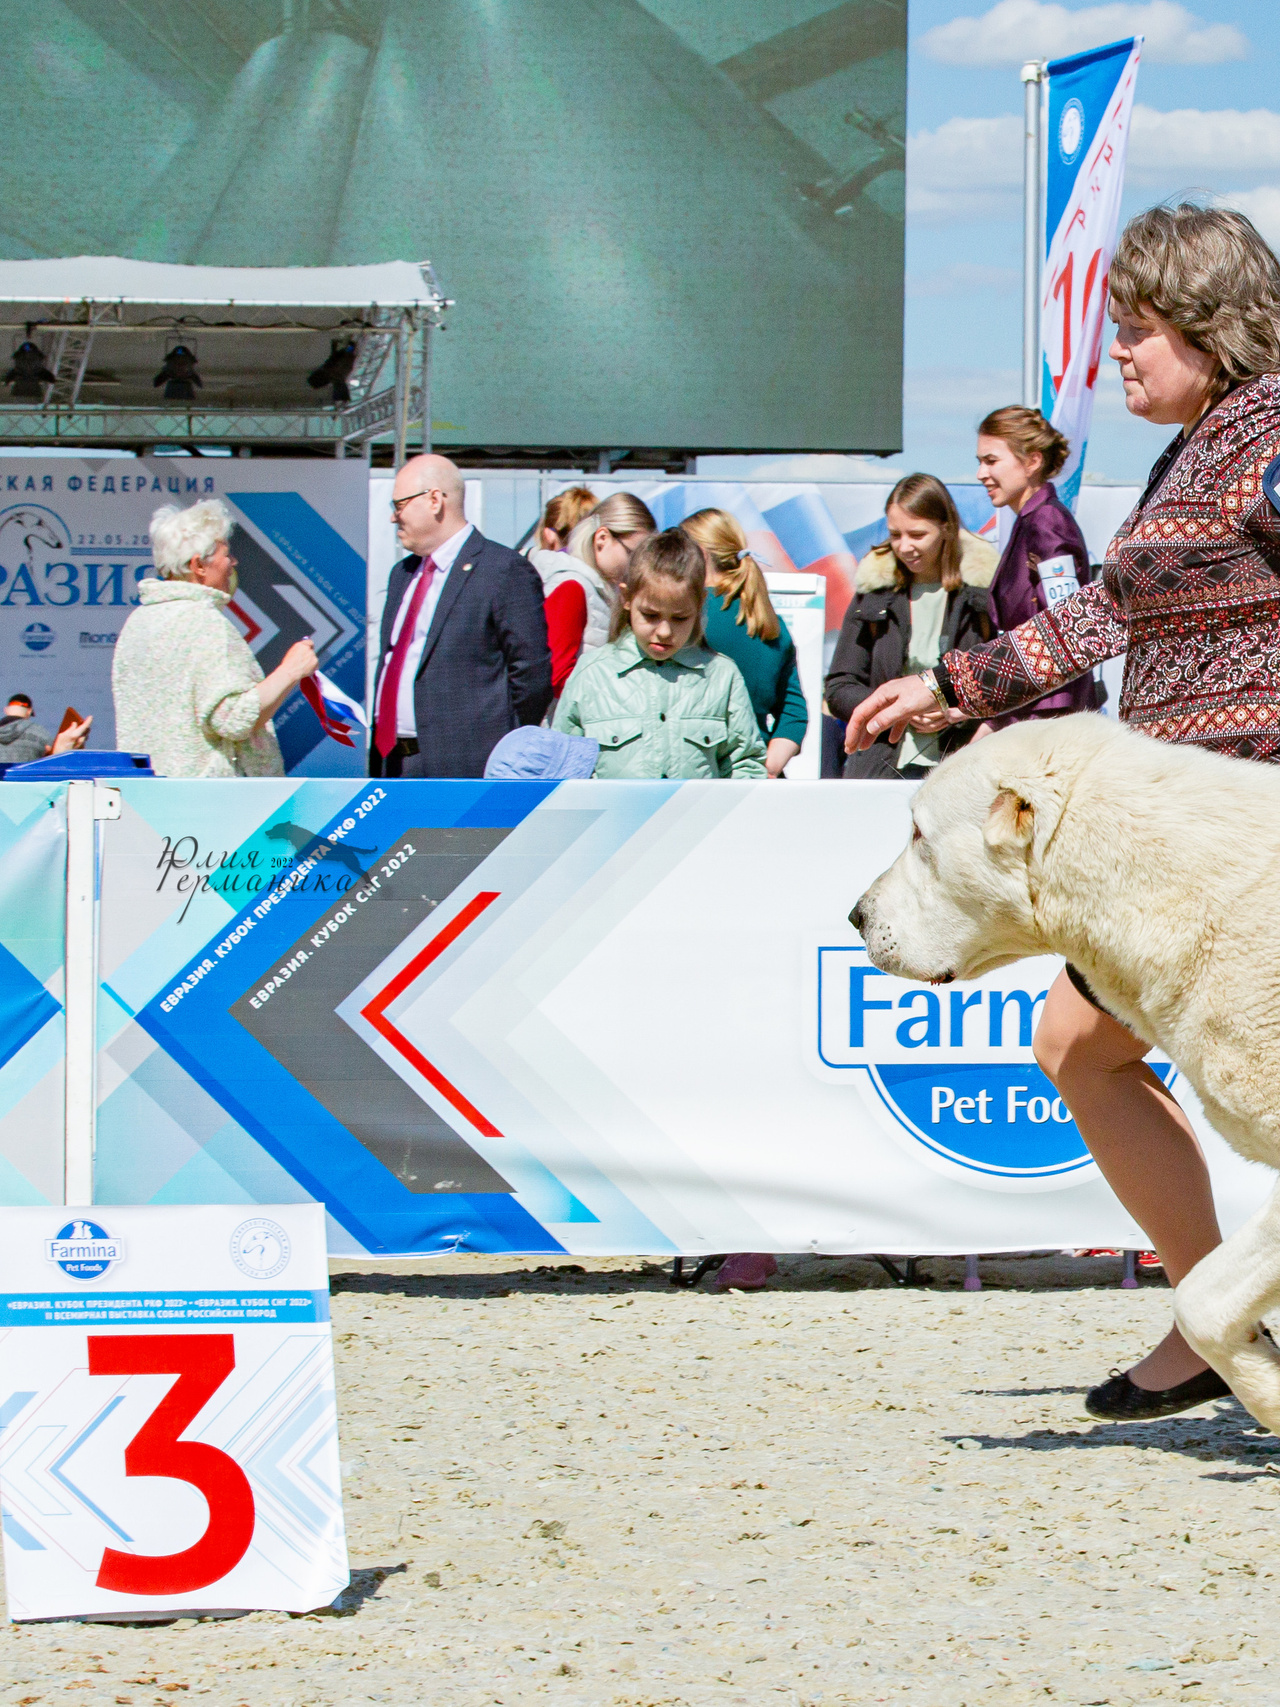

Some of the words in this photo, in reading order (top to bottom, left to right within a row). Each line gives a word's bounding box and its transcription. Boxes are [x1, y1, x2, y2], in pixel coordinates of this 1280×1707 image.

[0, 475, 53, 491] КАЯ
[67, 475, 215, 494] ФЕДЕРАЦИЯ
[78, 534, 150, 546] 22.05.20
[160, 958, 218, 1012] ЕВРАЗИЯ.
[214, 916, 257, 959] КУБОК
[253, 844, 331, 918] ПРЕЗИДЕНТА
[327, 816, 356, 845] РКФ
[354, 787, 387, 819] 2022
[249, 950, 313, 1009] ЕВРАЗИЯ.
[310, 903, 357, 947] КУБОК
[355, 876, 382, 903] СНГ
[380, 843, 416, 877] 2022
[850, 966, 1049, 1049] Farm
[931, 1086, 993, 1124] Pet
[1006, 1086, 1074, 1124] Foo
[50, 1242, 116, 1258] Farmina
[66, 1263, 80, 1272] Pet
[80, 1263, 103, 1272] Foods
[54, 1300, 85, 1309] КУБОК
[86, 1299, 143, 1308] ПРЕЗИДЕНТА
[143, 1299, 163, 1307] РКФ
[240, 1298, 270, 1306] КУБОК
[271, 1298, 287, 1306] СНГ
[54, 1311, 107, 1320] ВСЕМИРНАЯ
[108, 1310, 156, 1319] ВЫСТАВКА
[156, 1309, 186, 1318] СОБАК
[187, 1308, 245, 1318] РОССИЙСКИХ
[246, 1309, 277, 1318] ПОРОД
[87, 1333, 256, 1596] 3
